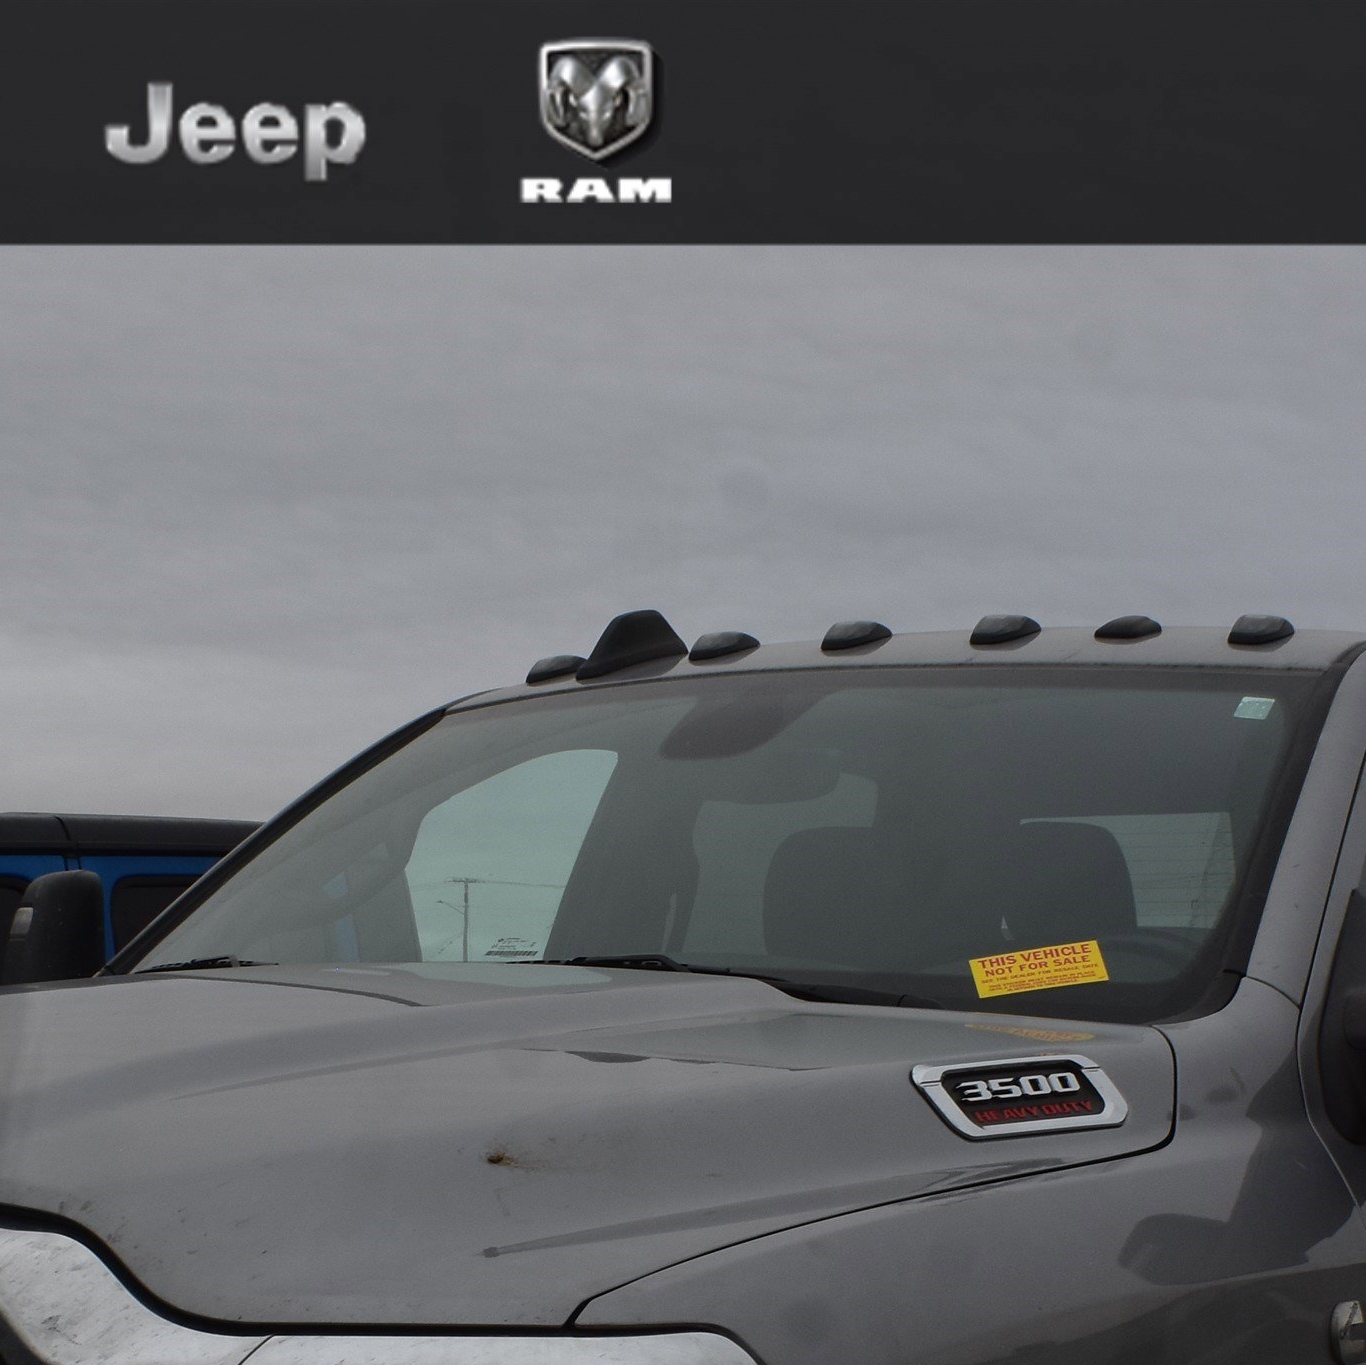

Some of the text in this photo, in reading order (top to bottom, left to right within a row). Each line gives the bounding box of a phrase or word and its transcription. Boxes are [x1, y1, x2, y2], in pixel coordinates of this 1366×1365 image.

[978, 943, 1092, 969] THIS VEHICLE
[985, 955, 1091, 977] NOT FOR SALE
[955, 1072, 1081, 1102] 3500
[975, 1099, 1094, 1124] HEAVY DUTY
